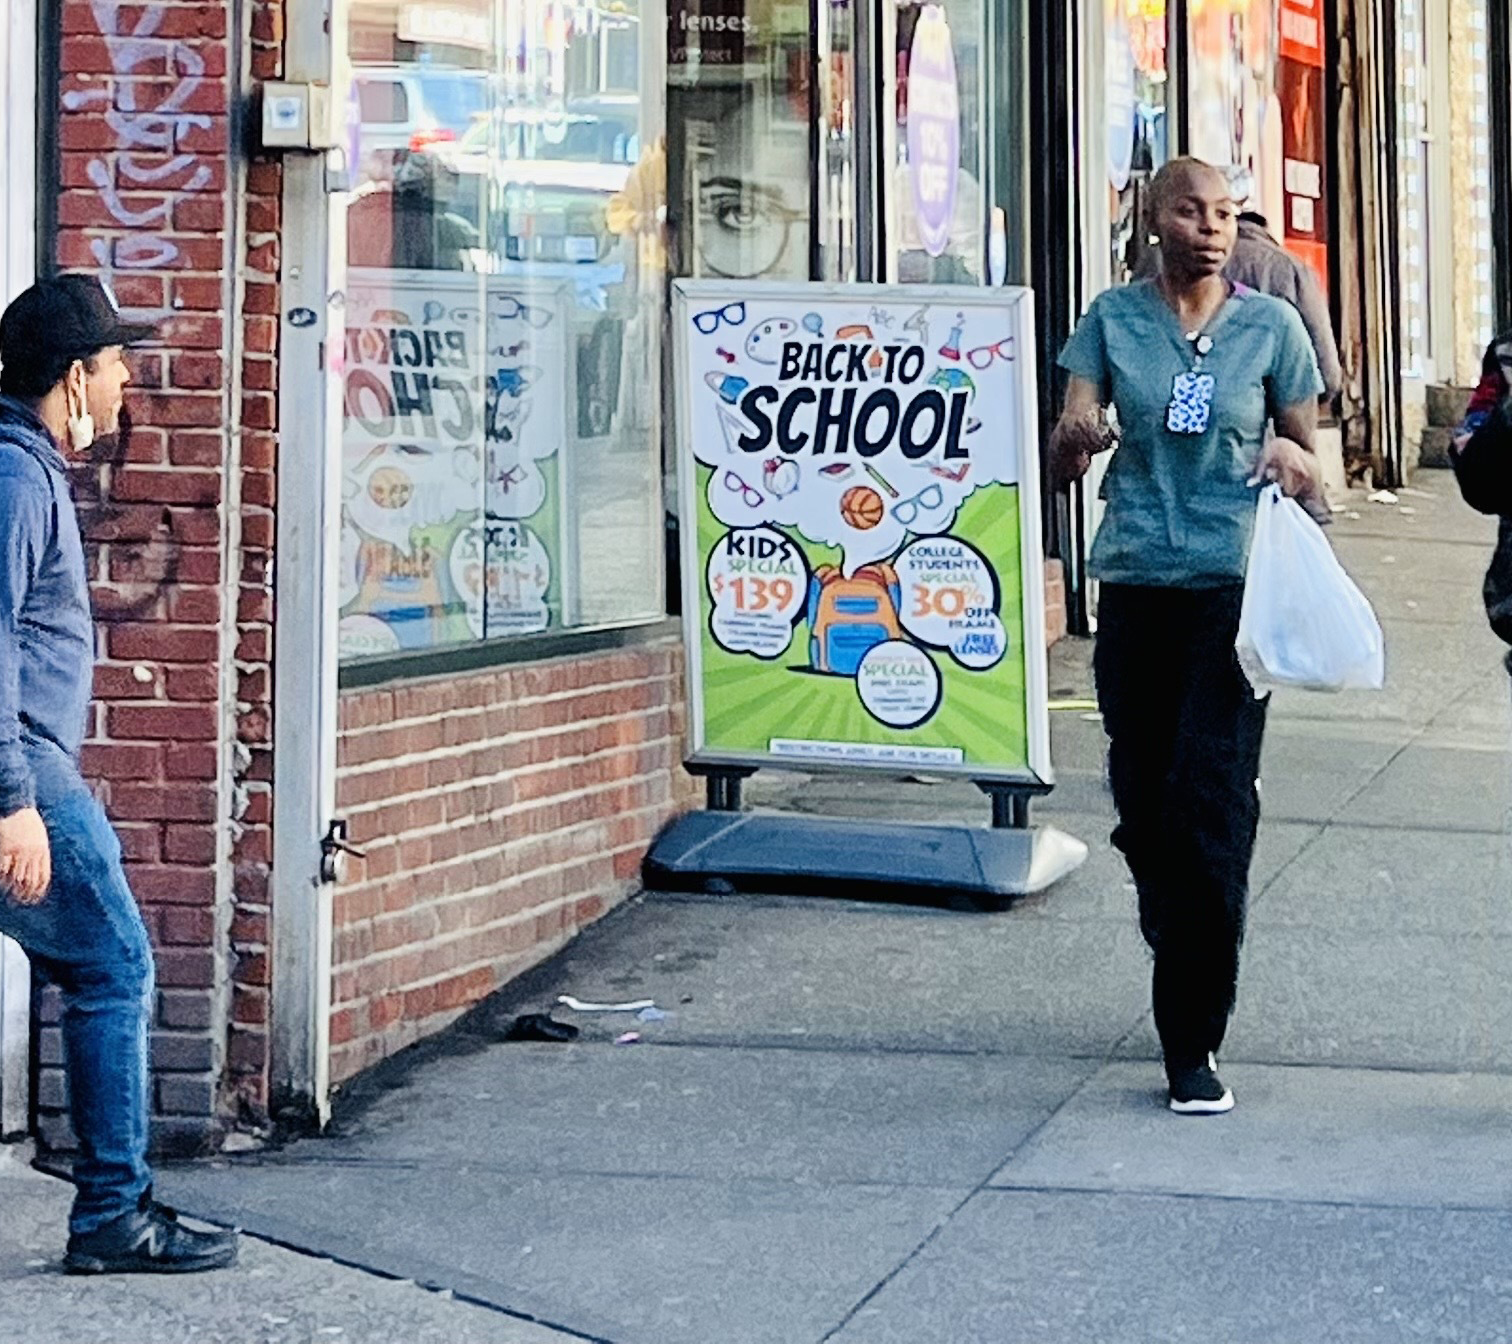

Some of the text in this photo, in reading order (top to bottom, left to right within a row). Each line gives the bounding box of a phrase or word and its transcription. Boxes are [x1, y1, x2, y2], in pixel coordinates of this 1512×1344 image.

[679, 13, 759, 32] lenses.
[778, 341, 925, 385] BACK TO
[737, 385, 971, 461] SCHOOL
[726, 531, 792, 563] KIDS
[908, 546, 965, 558] COLLEGE
[728, 559, 797, 575] SPECIAL
[908, 559, 981, 571] STUDENTS
[919, 572, 978, 584] SPECIAL
[713, 573, 794, 613] $139
[911, 583, 986, 618] 30%
[862, 663, 929, 677] SPECIAL
